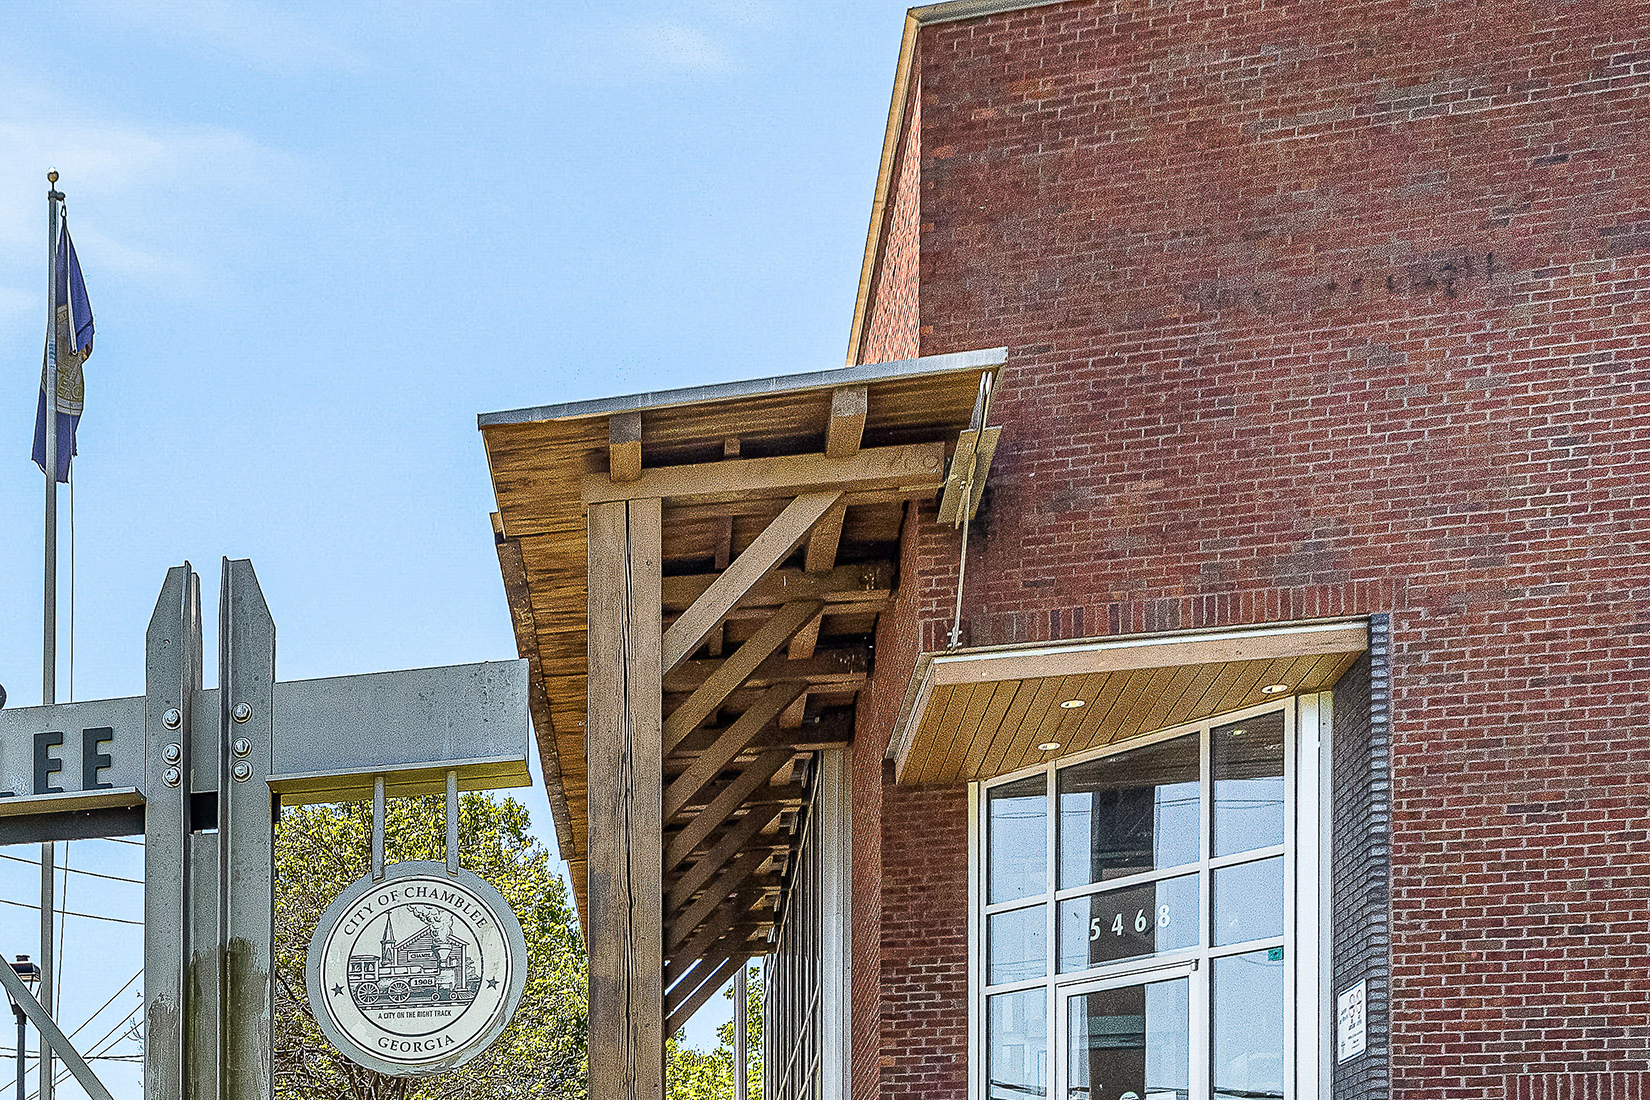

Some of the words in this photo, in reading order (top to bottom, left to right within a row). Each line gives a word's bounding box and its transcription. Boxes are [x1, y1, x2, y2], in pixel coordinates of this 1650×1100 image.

[343, 903, 375, 936] CITY
[378, 890, 399, 906] OF
[404, 886, 488, 929] CHAMBLEE
[1089, 903, 1171, 942] 5468
[417, 1010, 433, 1018] RIGHT
[434, 1009, 452, 1017] TRACK
[378, 1034, 456, 1053] GEORGIA
